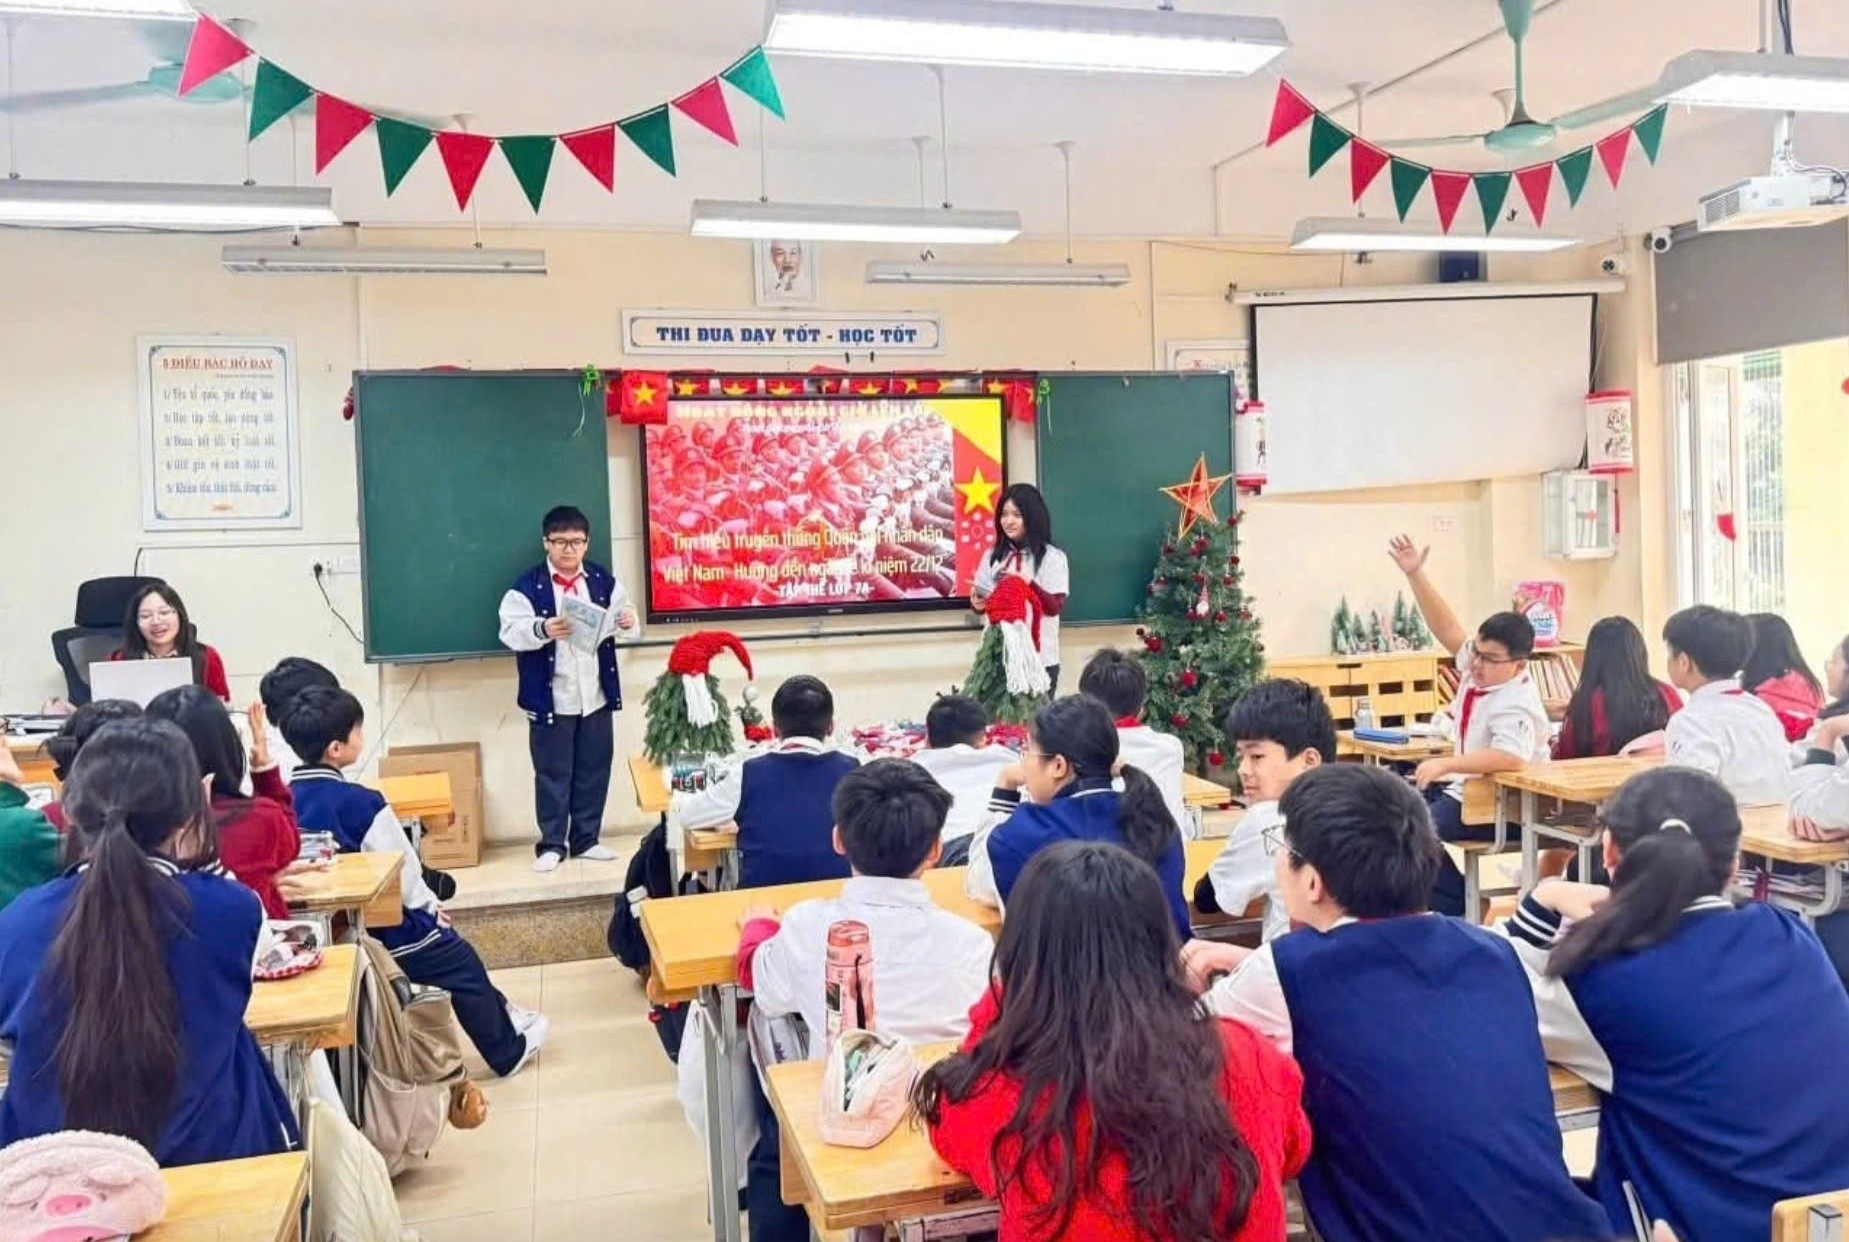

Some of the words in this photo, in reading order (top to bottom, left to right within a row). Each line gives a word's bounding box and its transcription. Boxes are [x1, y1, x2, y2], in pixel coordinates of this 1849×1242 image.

[656, 327, 690, 342] THI
[697, 327, 735, 342] ĐUA
[740, 328, 777, 345] DẠY
[783, 323, 821, 343] TỐT
[839, 328, 875, 346] HỌC
[880, 323, 918, 343] TỐT
[692, 563, 724, 581] Nam
